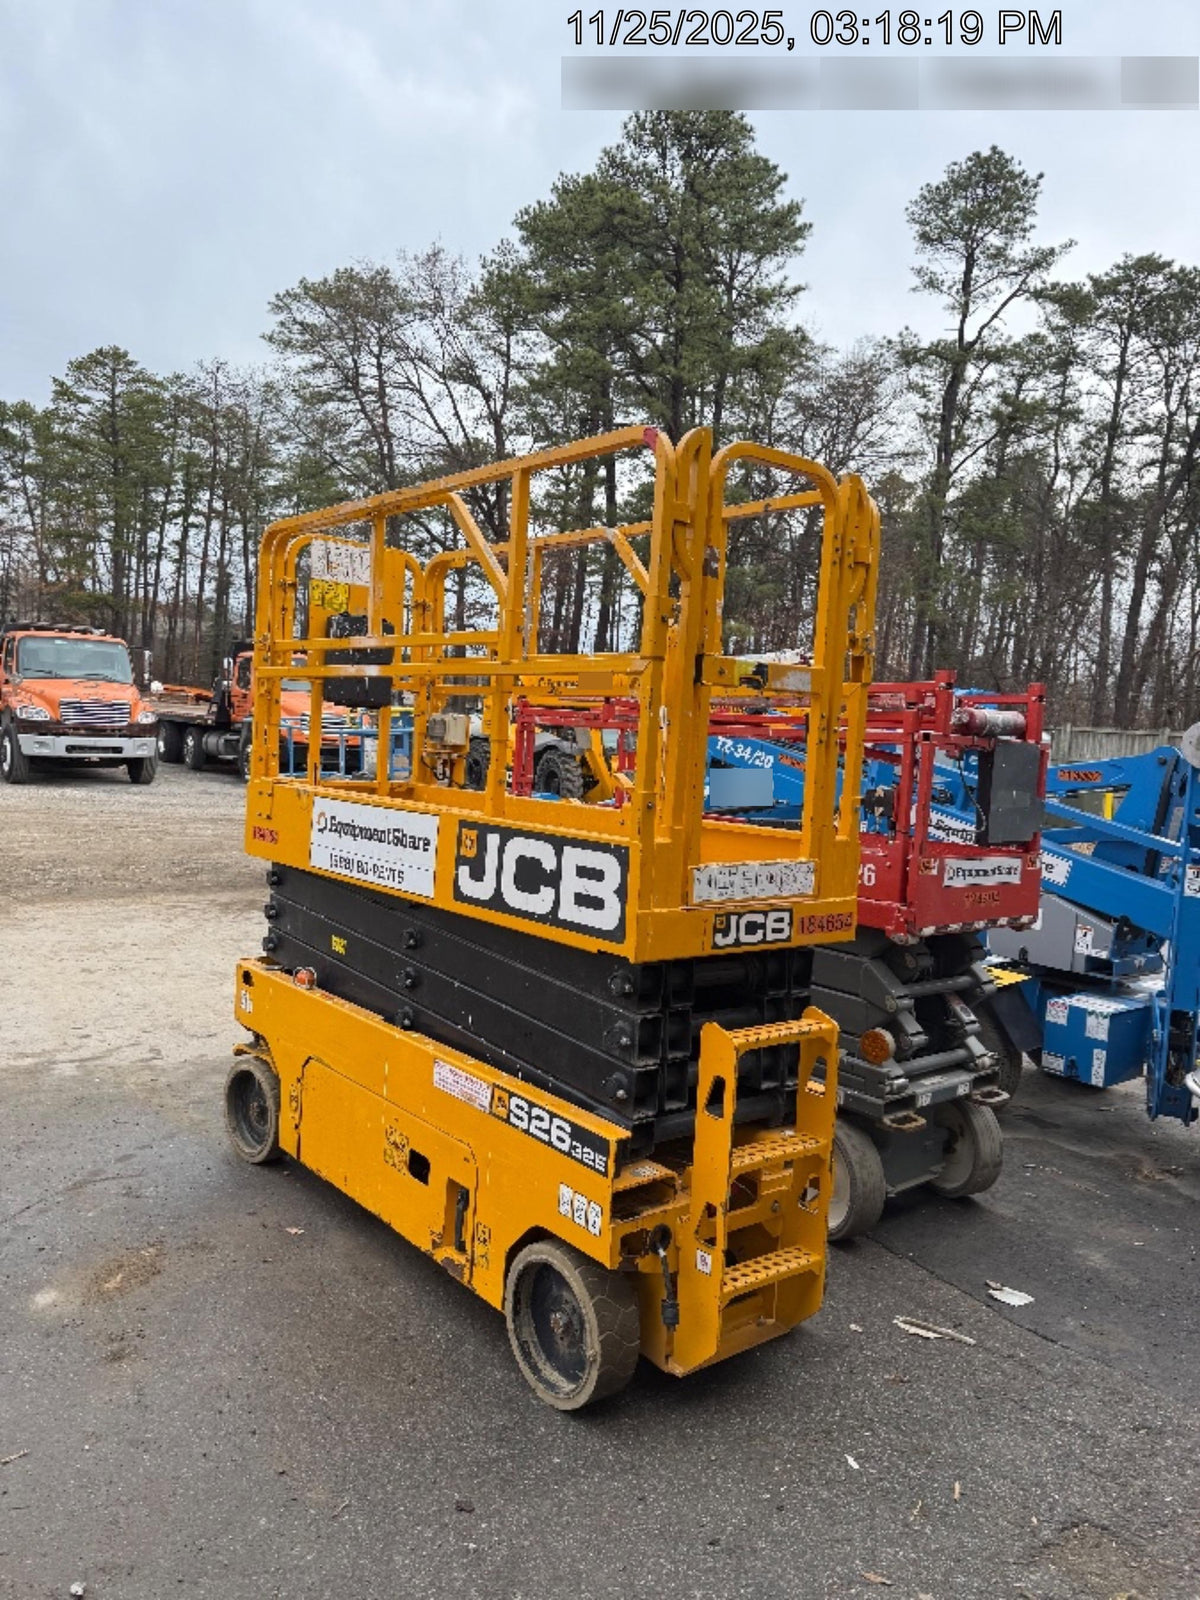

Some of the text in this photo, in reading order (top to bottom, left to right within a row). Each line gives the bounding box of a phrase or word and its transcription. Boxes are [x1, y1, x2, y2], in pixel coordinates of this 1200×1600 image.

[328, 815, 431, 852] EquipmentShare
[458, 833, 622, 931] JCB
[714, 911, 791, 946] JCB
